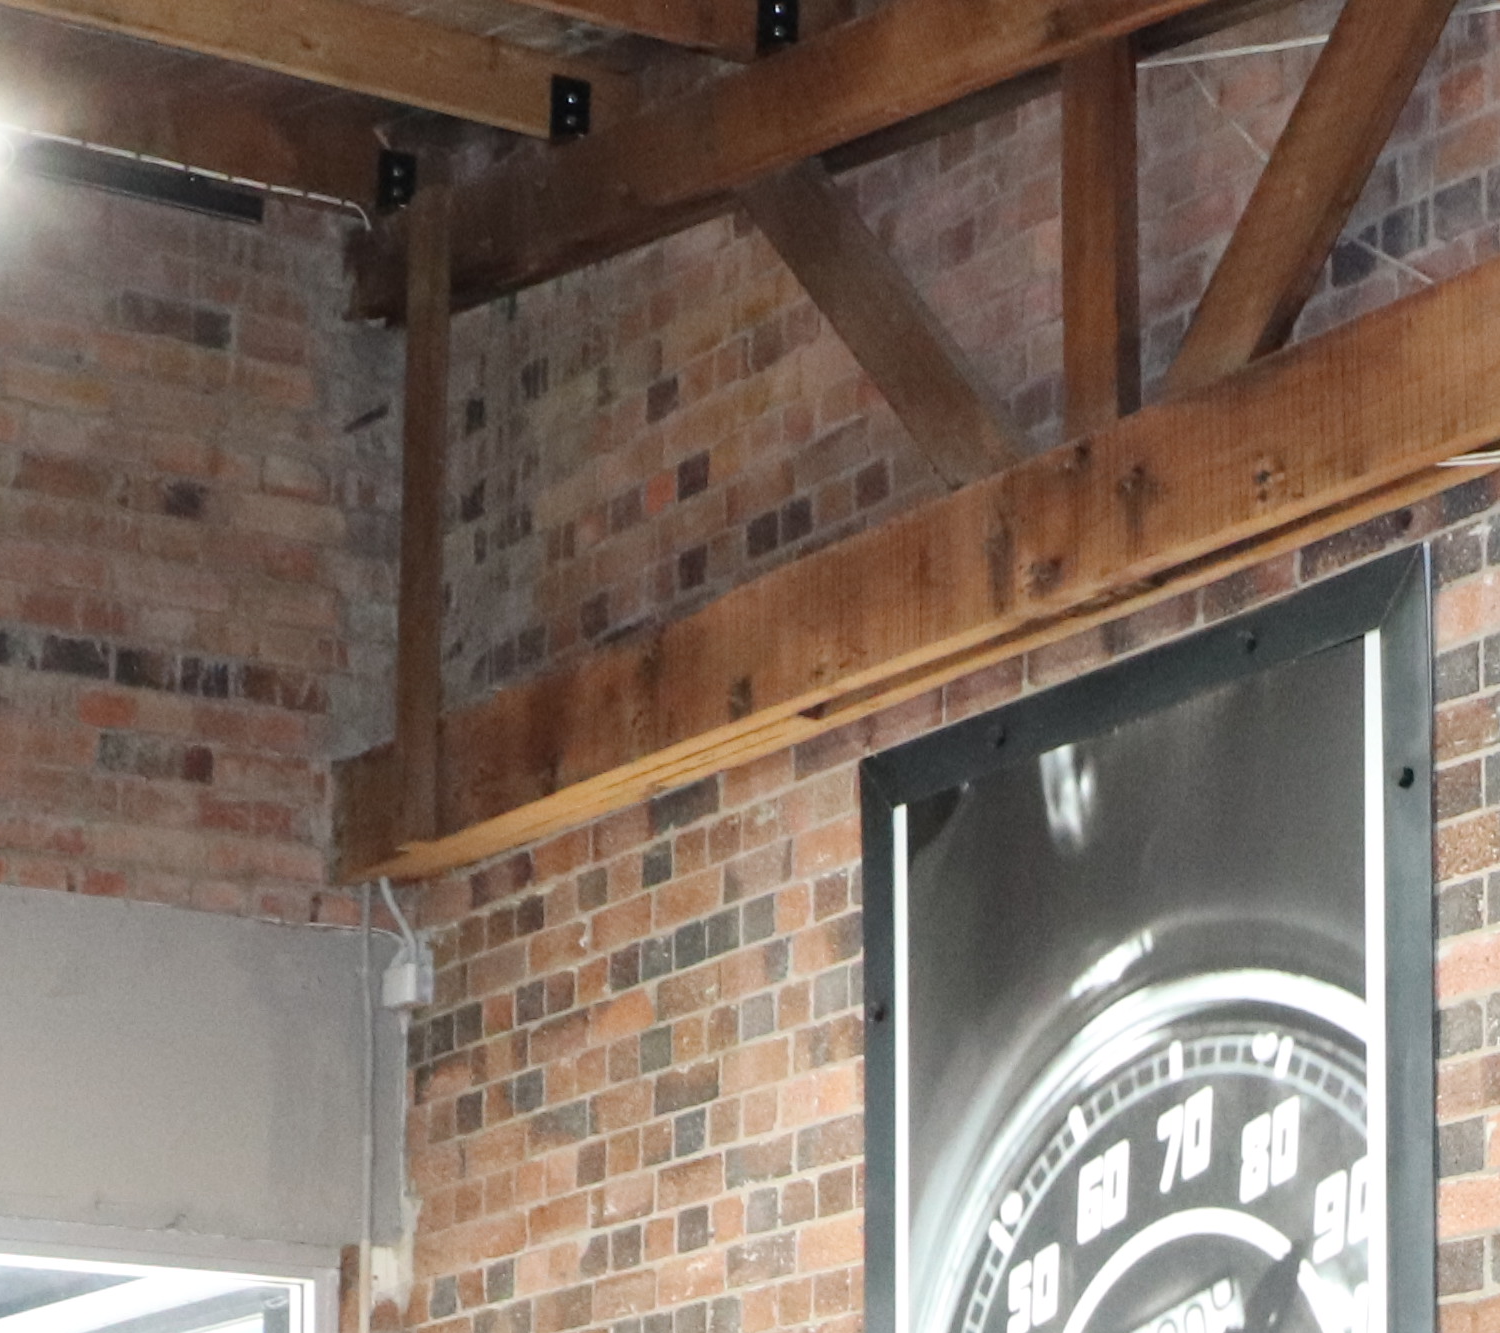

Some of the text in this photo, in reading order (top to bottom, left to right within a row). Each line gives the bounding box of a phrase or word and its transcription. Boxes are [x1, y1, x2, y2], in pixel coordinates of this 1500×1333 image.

[1077, 1138, 1130, 1245] 60
[1157, 1085, 1213, 1194] 70
[1239, 1095, 1300, 1204] 80
[1312, 1154, 1368, 1264] 90
